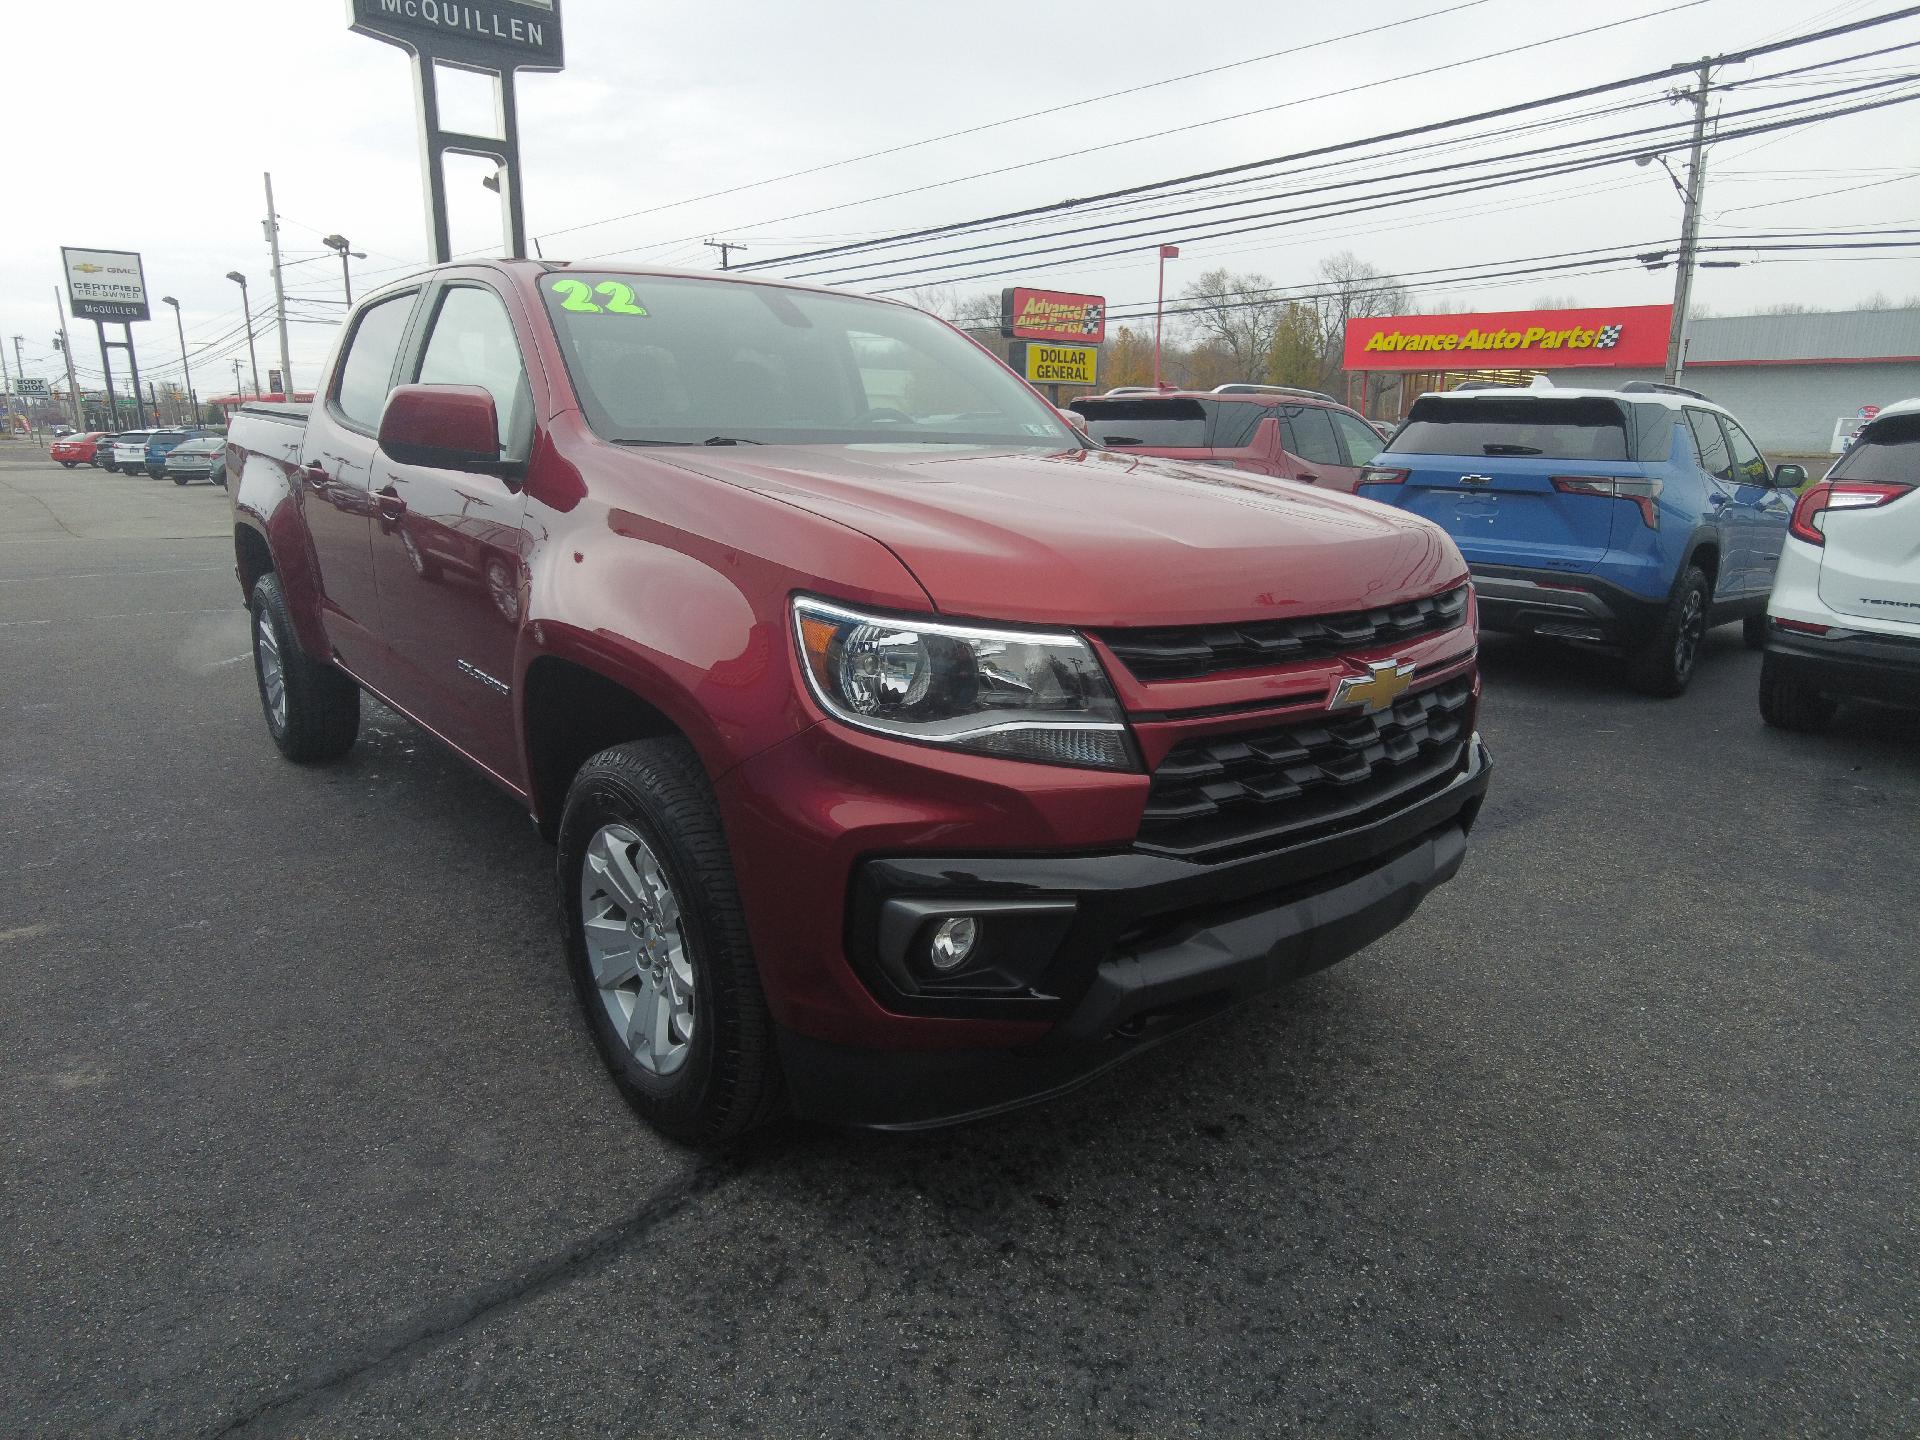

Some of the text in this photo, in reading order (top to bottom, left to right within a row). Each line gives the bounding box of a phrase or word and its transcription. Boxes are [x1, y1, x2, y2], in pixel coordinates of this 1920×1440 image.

[106, 267, 137, 275] GMC
[73, 282, 141, 293] CERTIFIED
[78, 289, 139, 299] PRE-OWNED
[552, 279, 647, 315] 22
[1022, 297, 1081, 320] Advance
[1016, 315, 1047, 331] Auto
[1365, 325, 1597, 351] Advance Auto Parts
[1040, 348, 1086, 366] DOLLAR
[1036, 364, 1088, 381] GENERAL
